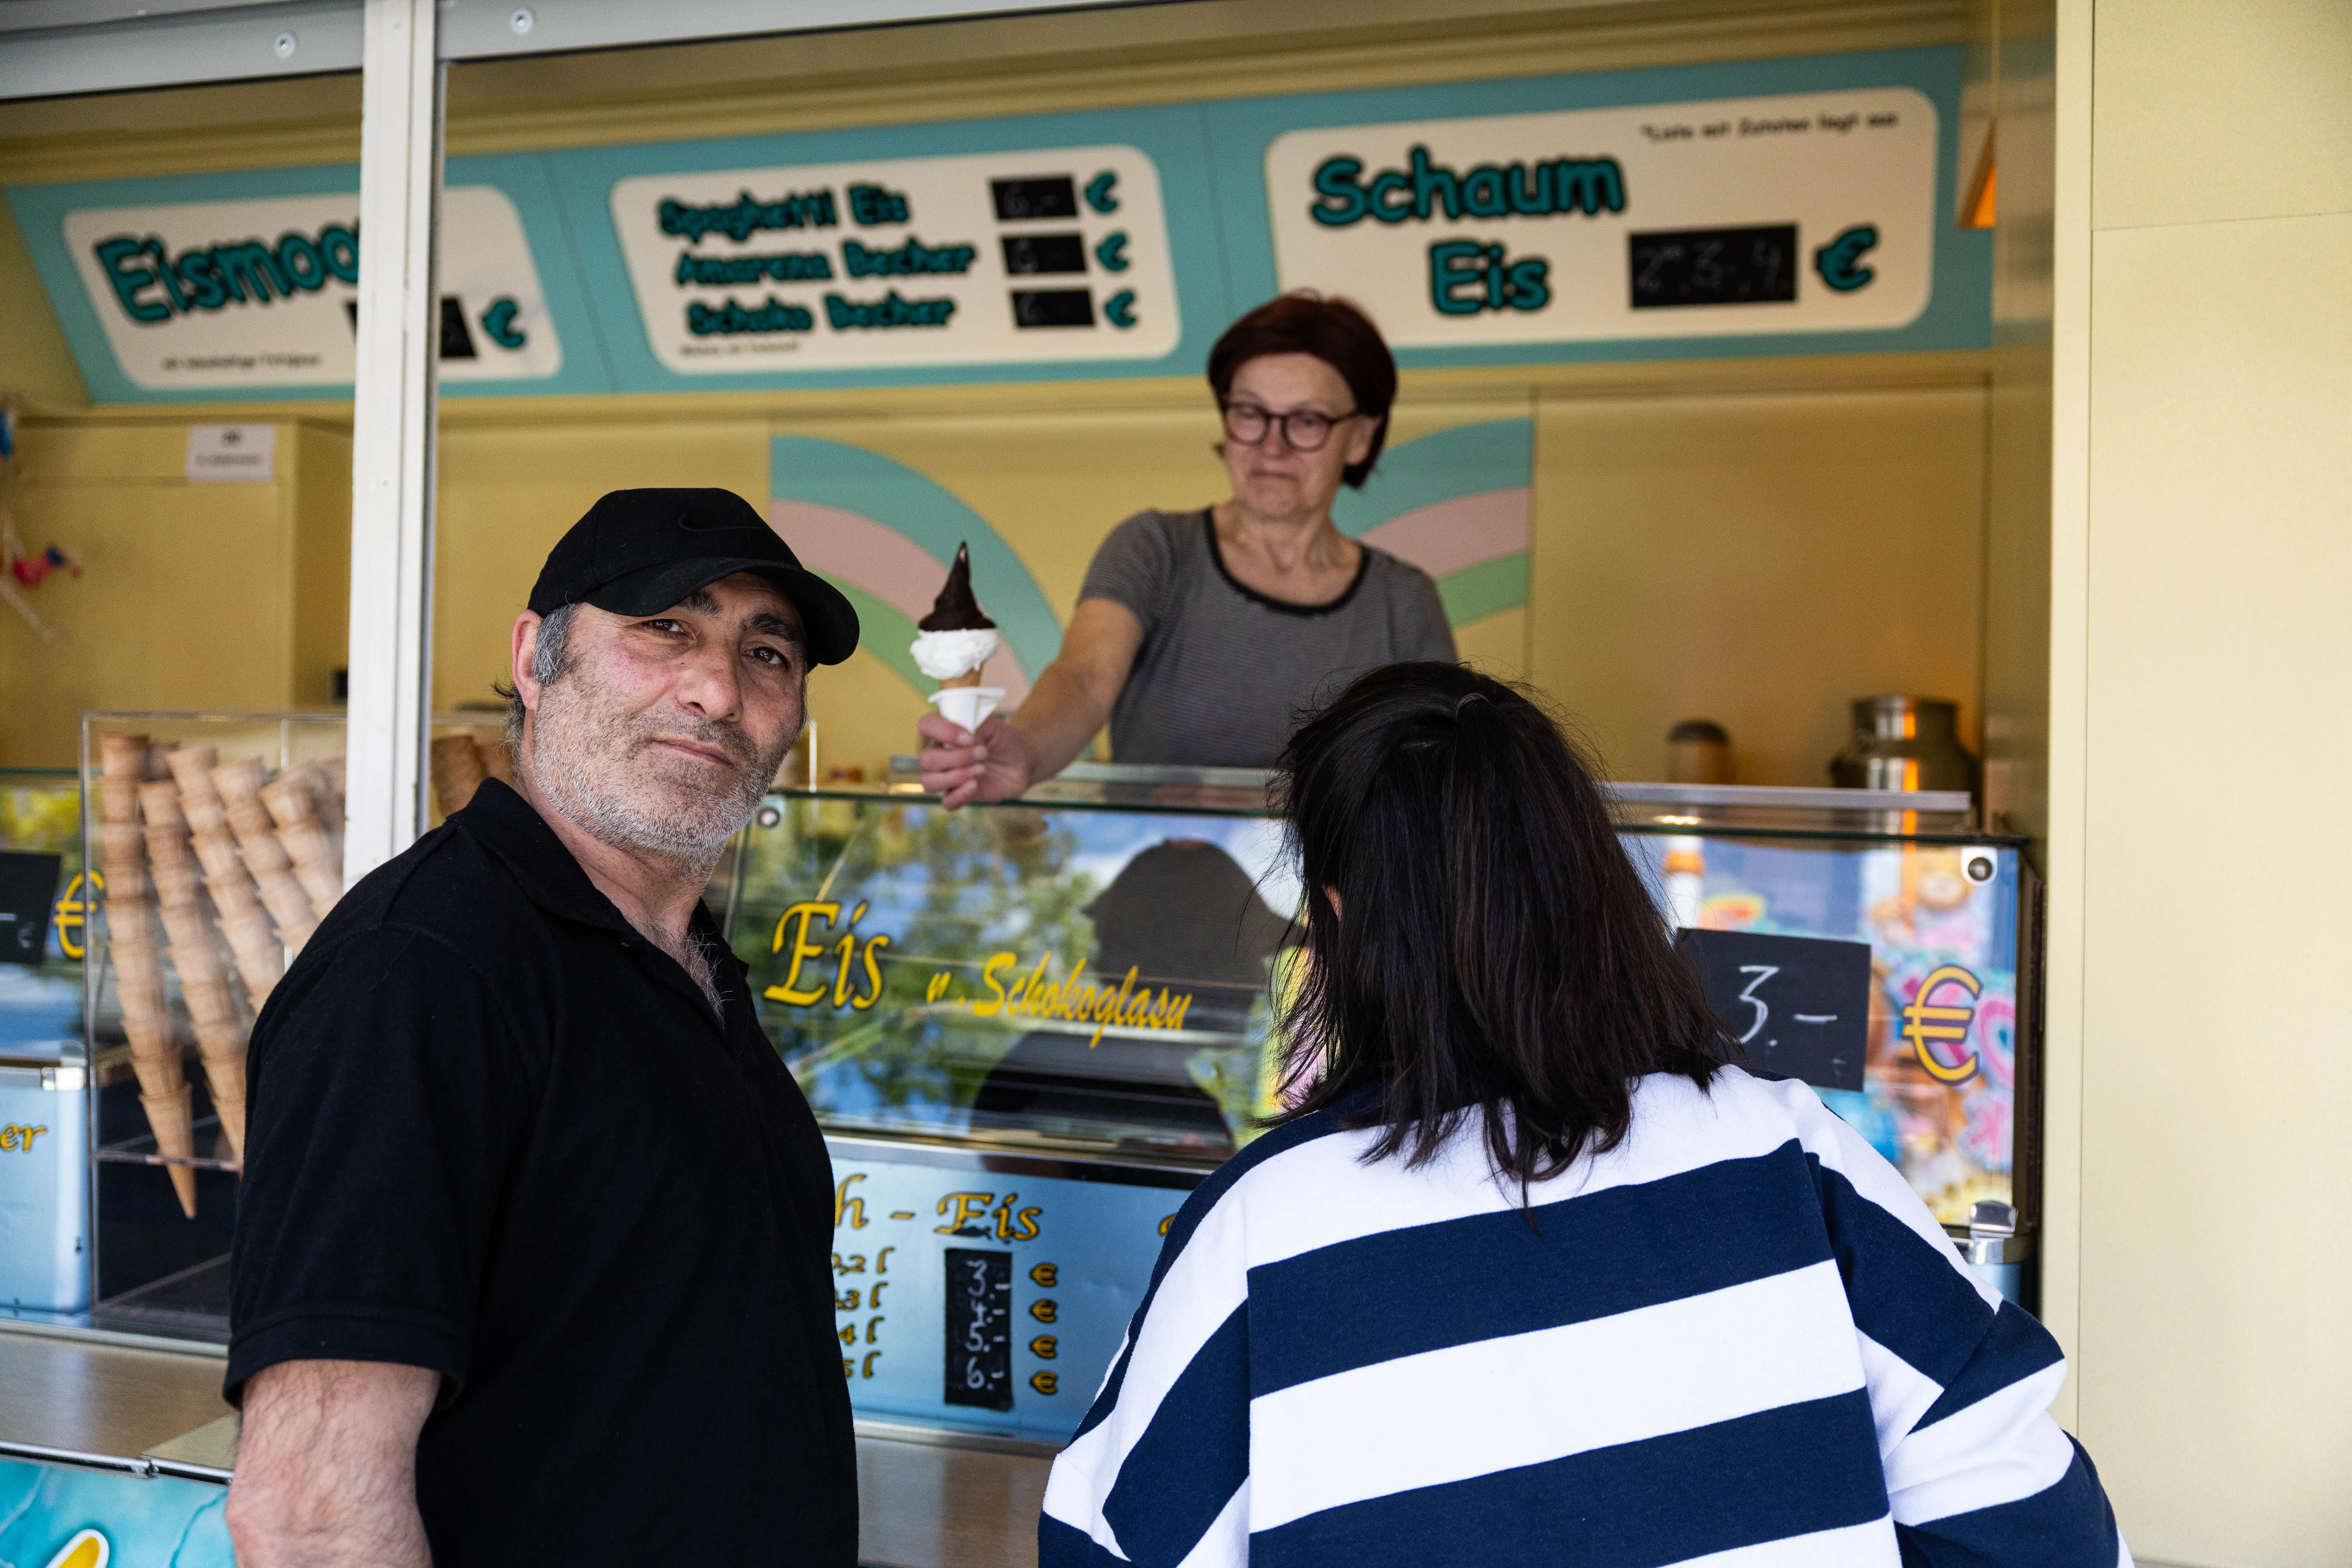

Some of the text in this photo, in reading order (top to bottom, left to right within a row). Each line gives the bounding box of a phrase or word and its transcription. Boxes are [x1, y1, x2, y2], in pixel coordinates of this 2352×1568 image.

[1310, 144, 1626, 227] Schaum
[657, 190, 839, 245] Spaghetti
[845, 183, 910, 227] Eis
[841, 236, 976, 279] Becher
[1429, 240, 1551, 317] Eis
[1816, 225, 1878, 293] €
[687, 298, 815, 336] Schoko
[822, 289, 955, 330] Becher
[761, 900, 891, 1011] Eis
[1900, 964, 1984, 1087] €
[933, 1191, 1043, 1241] Eis
[1029, 1262, 1058, 1287] €
[1029, 1298, 1058, 1323] €
[1029, 1335, 1058, 1359] €
[966, 1356, 1005, 1390] 6.-
[1029, 1370, 1058, 1396] €
